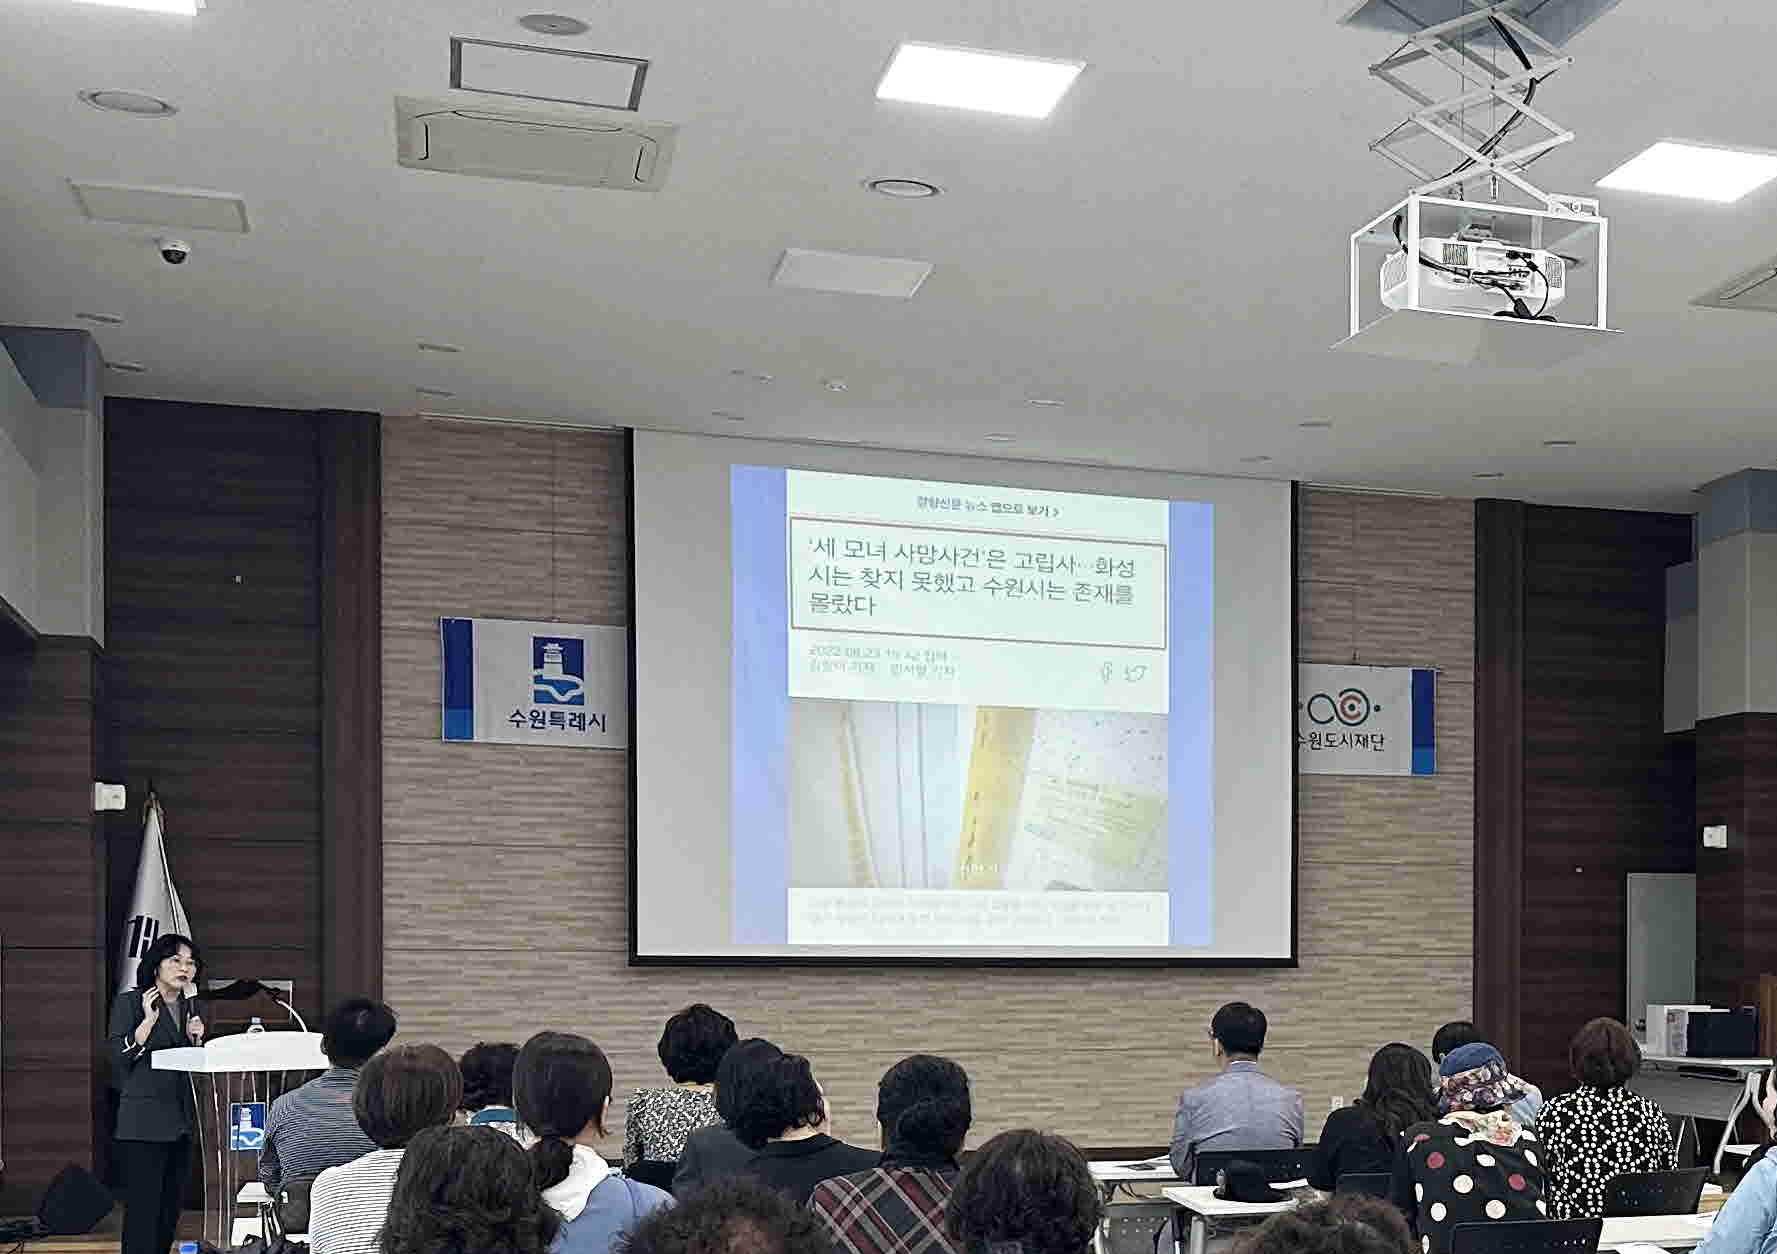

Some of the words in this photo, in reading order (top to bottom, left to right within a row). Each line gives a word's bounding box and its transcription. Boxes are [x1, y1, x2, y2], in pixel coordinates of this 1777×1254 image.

[844, 540, 886, 561] 모녀
[808, 565, 854, 587] 시는
[860, 568, 903, 591] 찾지
[912, 570, 975, 593] 못했고
[984, 577, 1065, 600] 수원시는
[1073, 582, 1134, 605] 존재를
[808, 592, 877, 616] 몰랐다
[508, 709, 607, 733] 수원특례시
